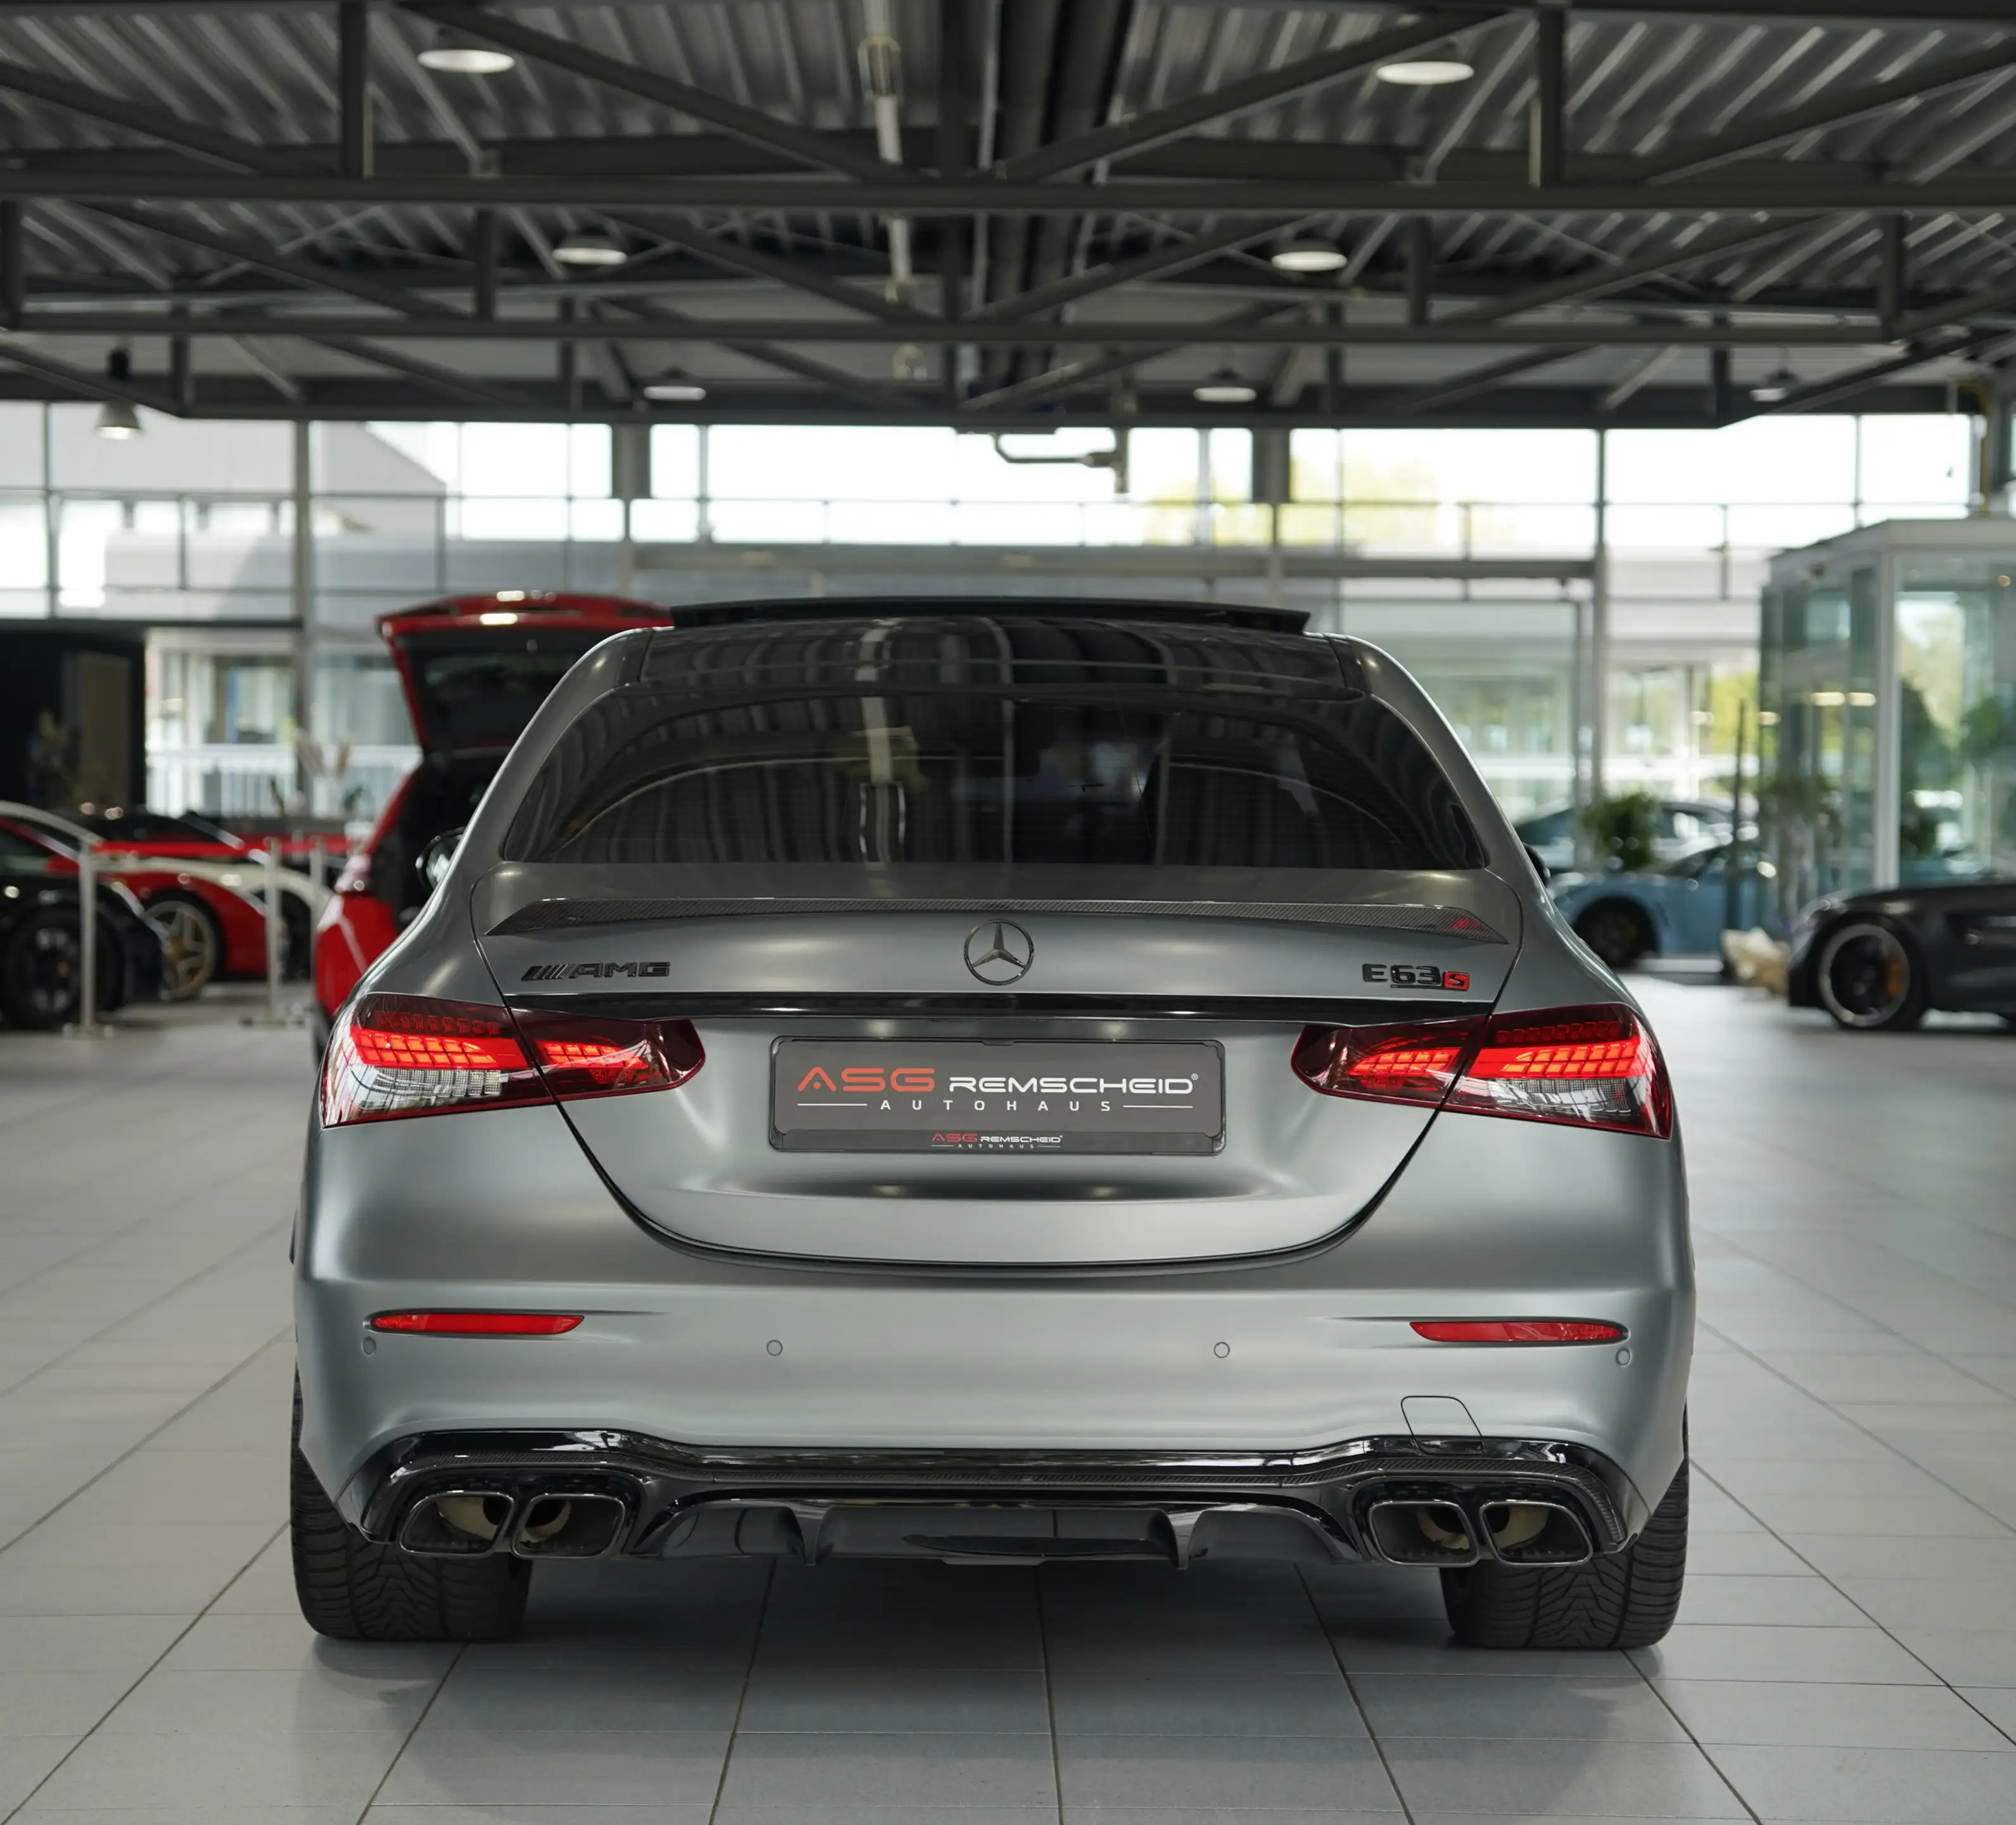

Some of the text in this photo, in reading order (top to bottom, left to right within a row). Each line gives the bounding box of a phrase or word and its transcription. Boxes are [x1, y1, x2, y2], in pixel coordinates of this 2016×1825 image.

[797, 1066, 935, 1092] ASG
[879, 1099, 1111, 1112] AUTOHAUS
[931, 1133, 978, 1143] ASG
